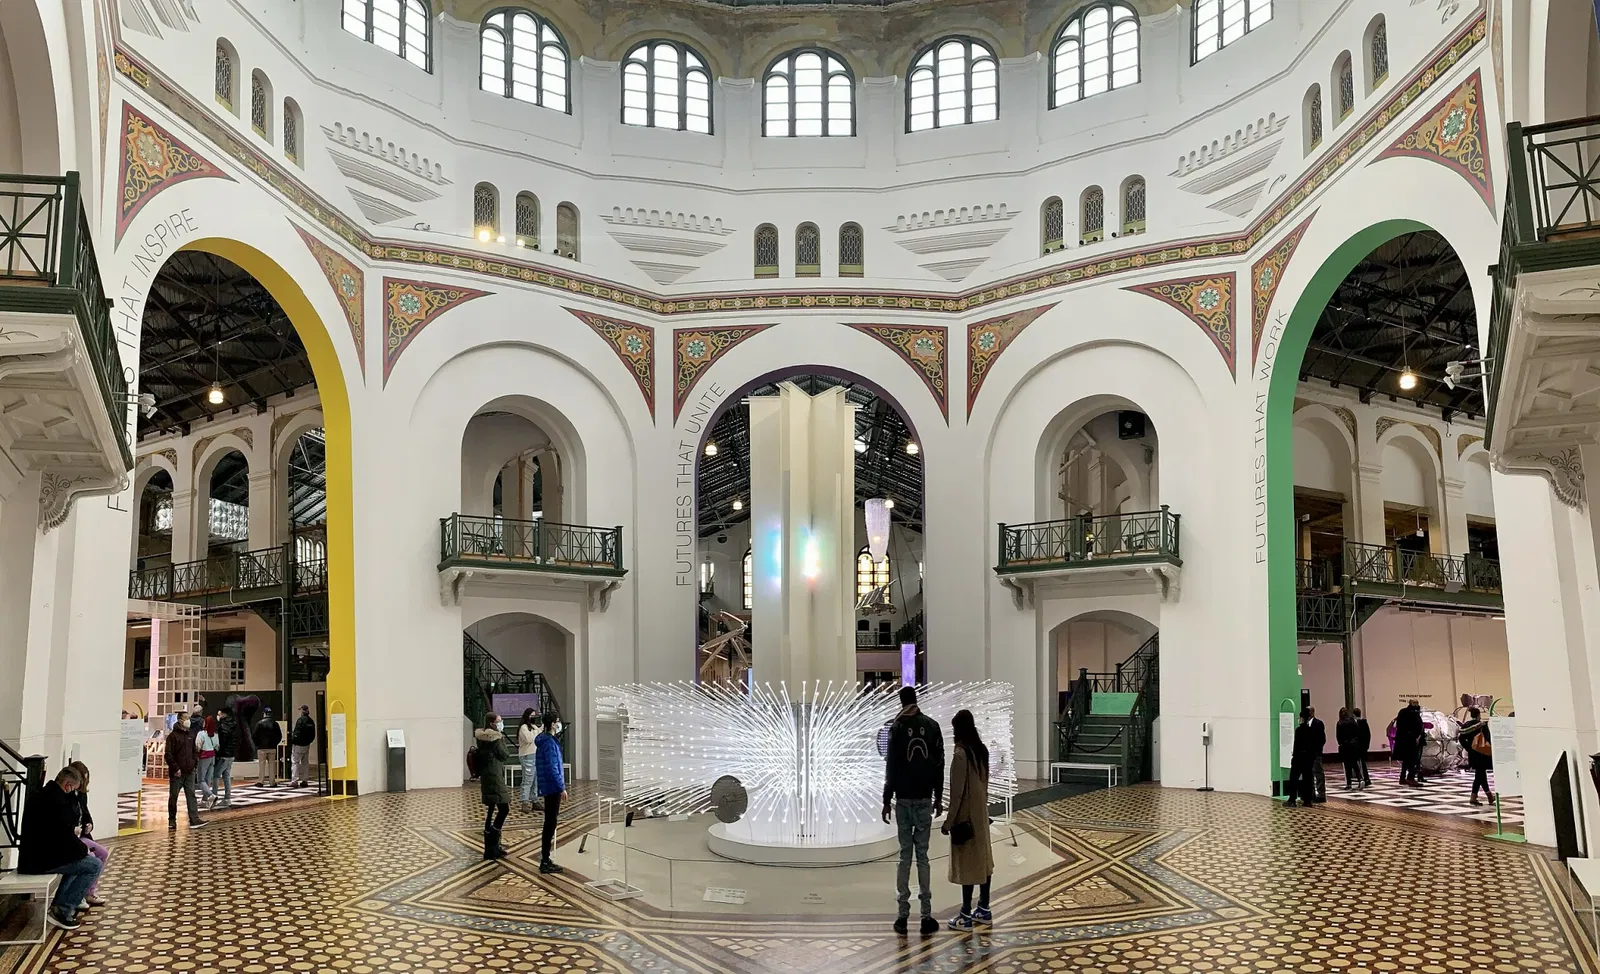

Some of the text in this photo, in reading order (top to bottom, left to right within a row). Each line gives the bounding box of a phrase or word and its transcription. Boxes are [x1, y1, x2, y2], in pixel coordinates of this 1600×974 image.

[116, 275, 142, 349] THAT
[131, 208, 199, 278] INSPIRE
[676, 382, 726, 586] FUTURES THAT UNITE
[1254, 309, 1287, 564] FUTURES THAT WORK
